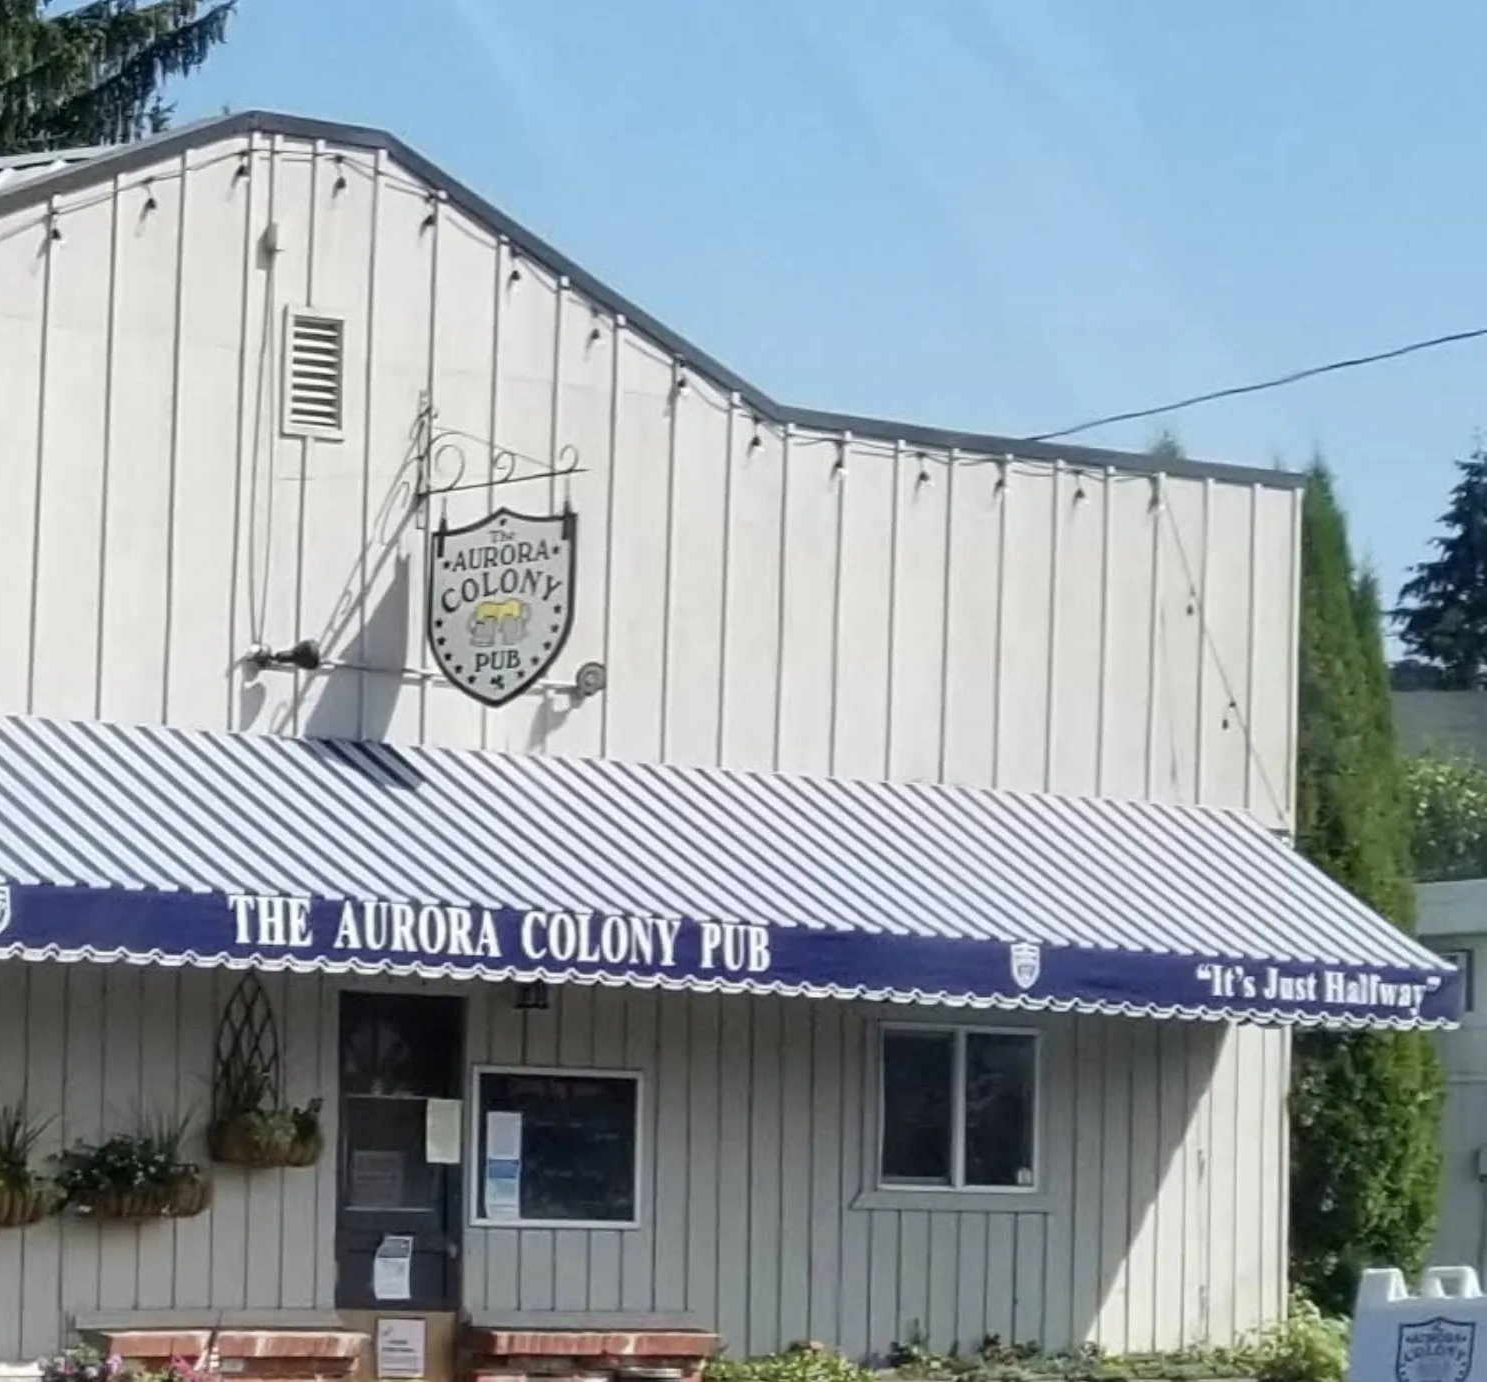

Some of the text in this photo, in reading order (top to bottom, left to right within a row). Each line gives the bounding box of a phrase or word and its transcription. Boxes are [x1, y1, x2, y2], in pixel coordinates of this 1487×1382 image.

[451, 538, 551, 572] AURORA
[440, 567, 564, 614] COLONY
[473, 649, 522, 673] PUB
[227, 894, 771, 972] THE AURORA COLONY PUB
[1262, 966, 1318, 1001] Just
